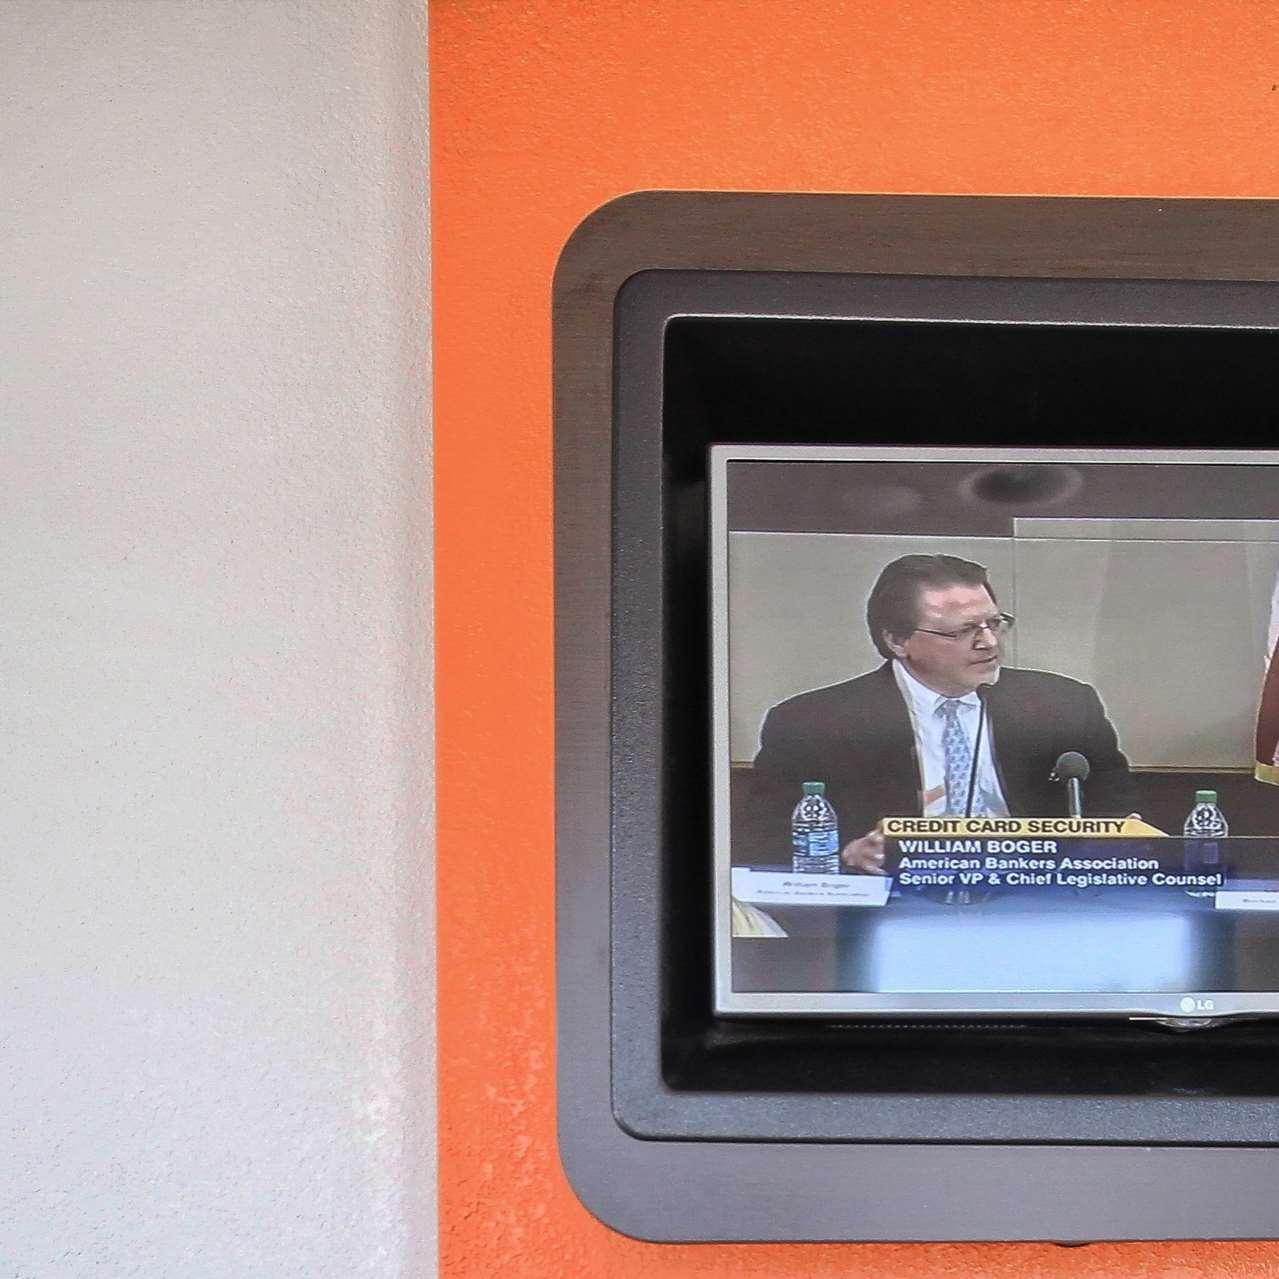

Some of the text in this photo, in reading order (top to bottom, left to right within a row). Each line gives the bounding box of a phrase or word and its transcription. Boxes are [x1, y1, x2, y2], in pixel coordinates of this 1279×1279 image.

[887, 819, 1127, 834] CREDIT CARD SECURITY
[898, 840, 1058, 854] WILLIAM BOGER
[898, 857, 1160, 871] American Bankers Association
[898, 872, 1223, 889] Senior VP & Chief Legislative Counsel
[1197, 999, 1214, 1011] LG
